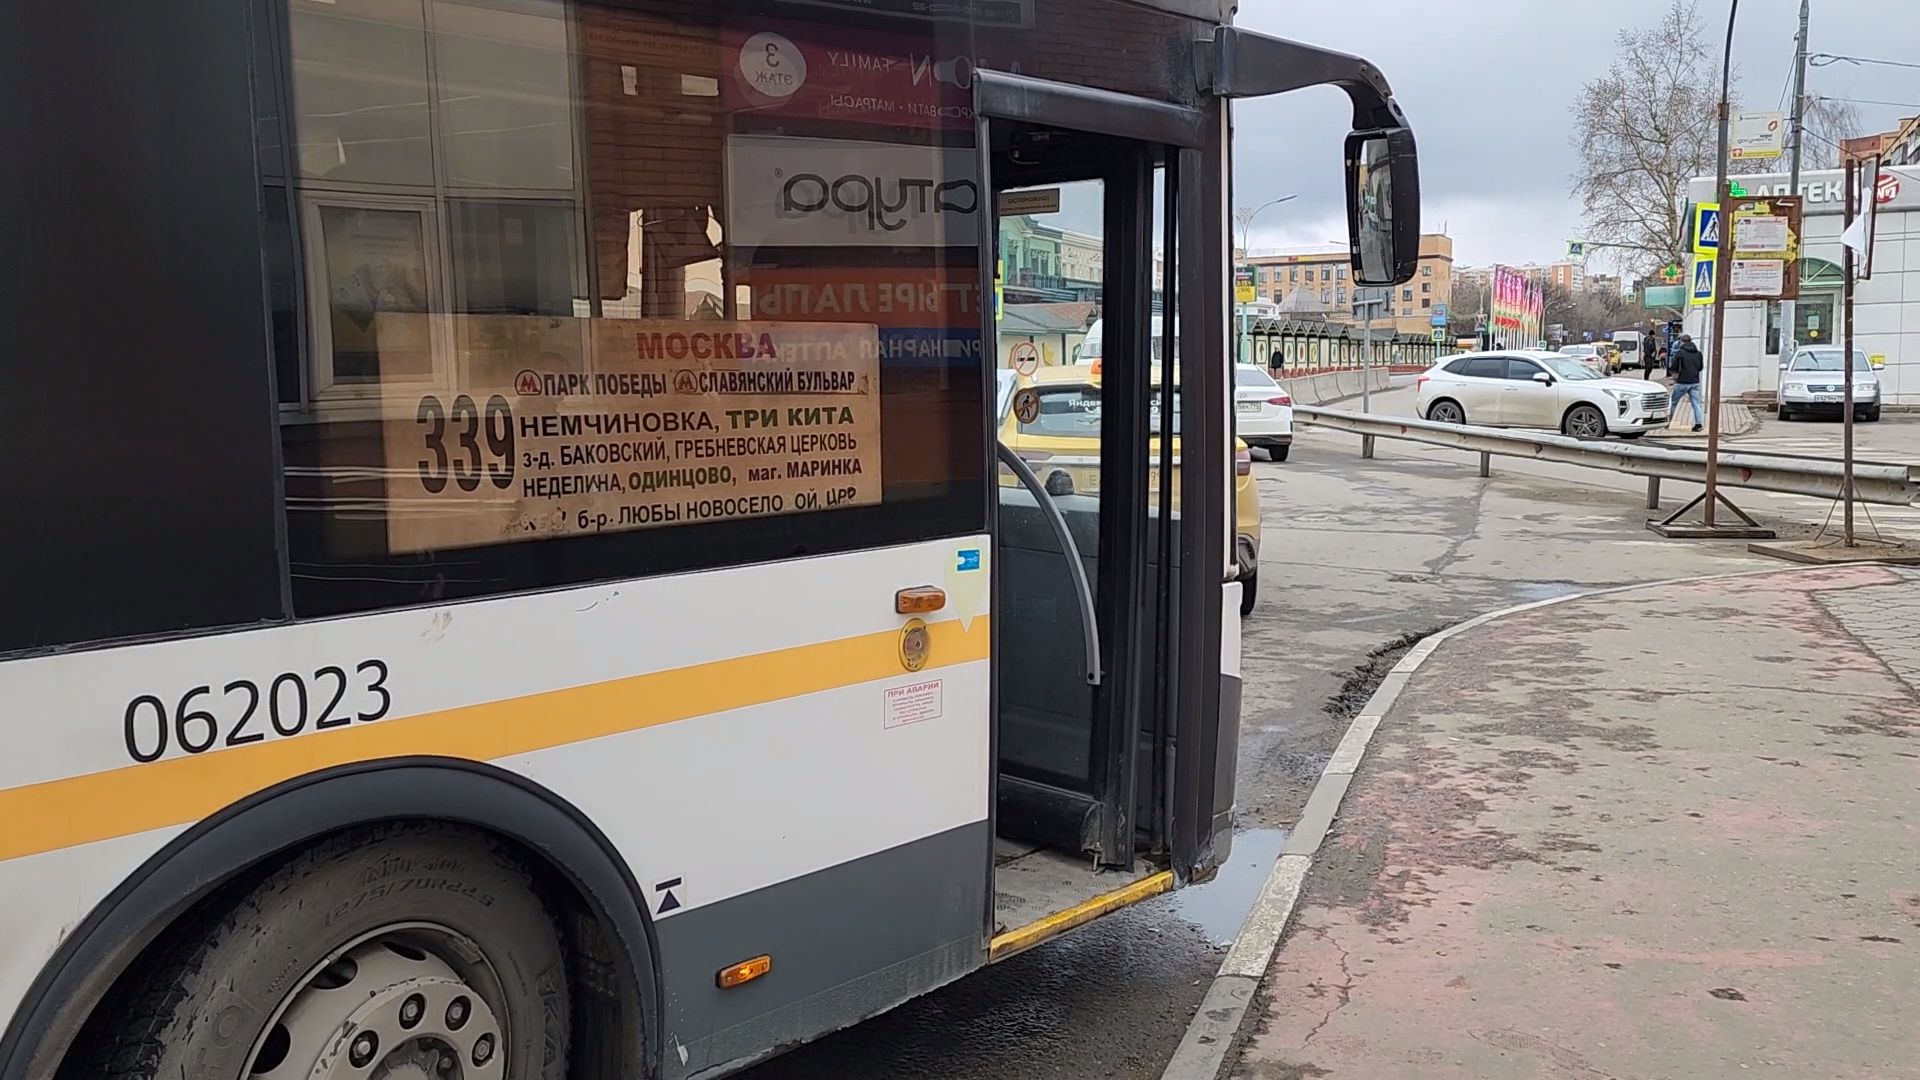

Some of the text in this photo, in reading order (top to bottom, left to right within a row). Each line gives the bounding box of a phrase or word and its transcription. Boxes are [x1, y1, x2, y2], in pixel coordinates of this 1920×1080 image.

[1756, 180, 1858, 204] АПТЕК
[636, 332, 777, 360] МОСКВА
[543, 374, 591, 396] ПАРК
[595, 373, 667, 398] ПОБЕДЫ
[699, 368, 794, 393] СЛАВЯНСКИЙ
[797, 371, 855, 392] БУЛЬВАР
[520, 406, 855, 438] НЕМЧИНОВКА, ТРИ КИТА
[417, 394, 515, 494] 339
[560, 436, 671, 466] БАКОВСКИЙ,
[675, 435, 786, 460] ГРЕБНЕВСКАЯ
[791, 433, 857, 456] ЦЕРКОВЬ
[523, 458, 863, 499] НЕДЕЛИНА, ОДИНЦОВО, маг. МАРИНКА
[618, 502, 680, 524] ЛЮБЫ
[887, 682, 940, 699] ПРИ АВАРИИ
[124, 659, 391, 763] 062023
